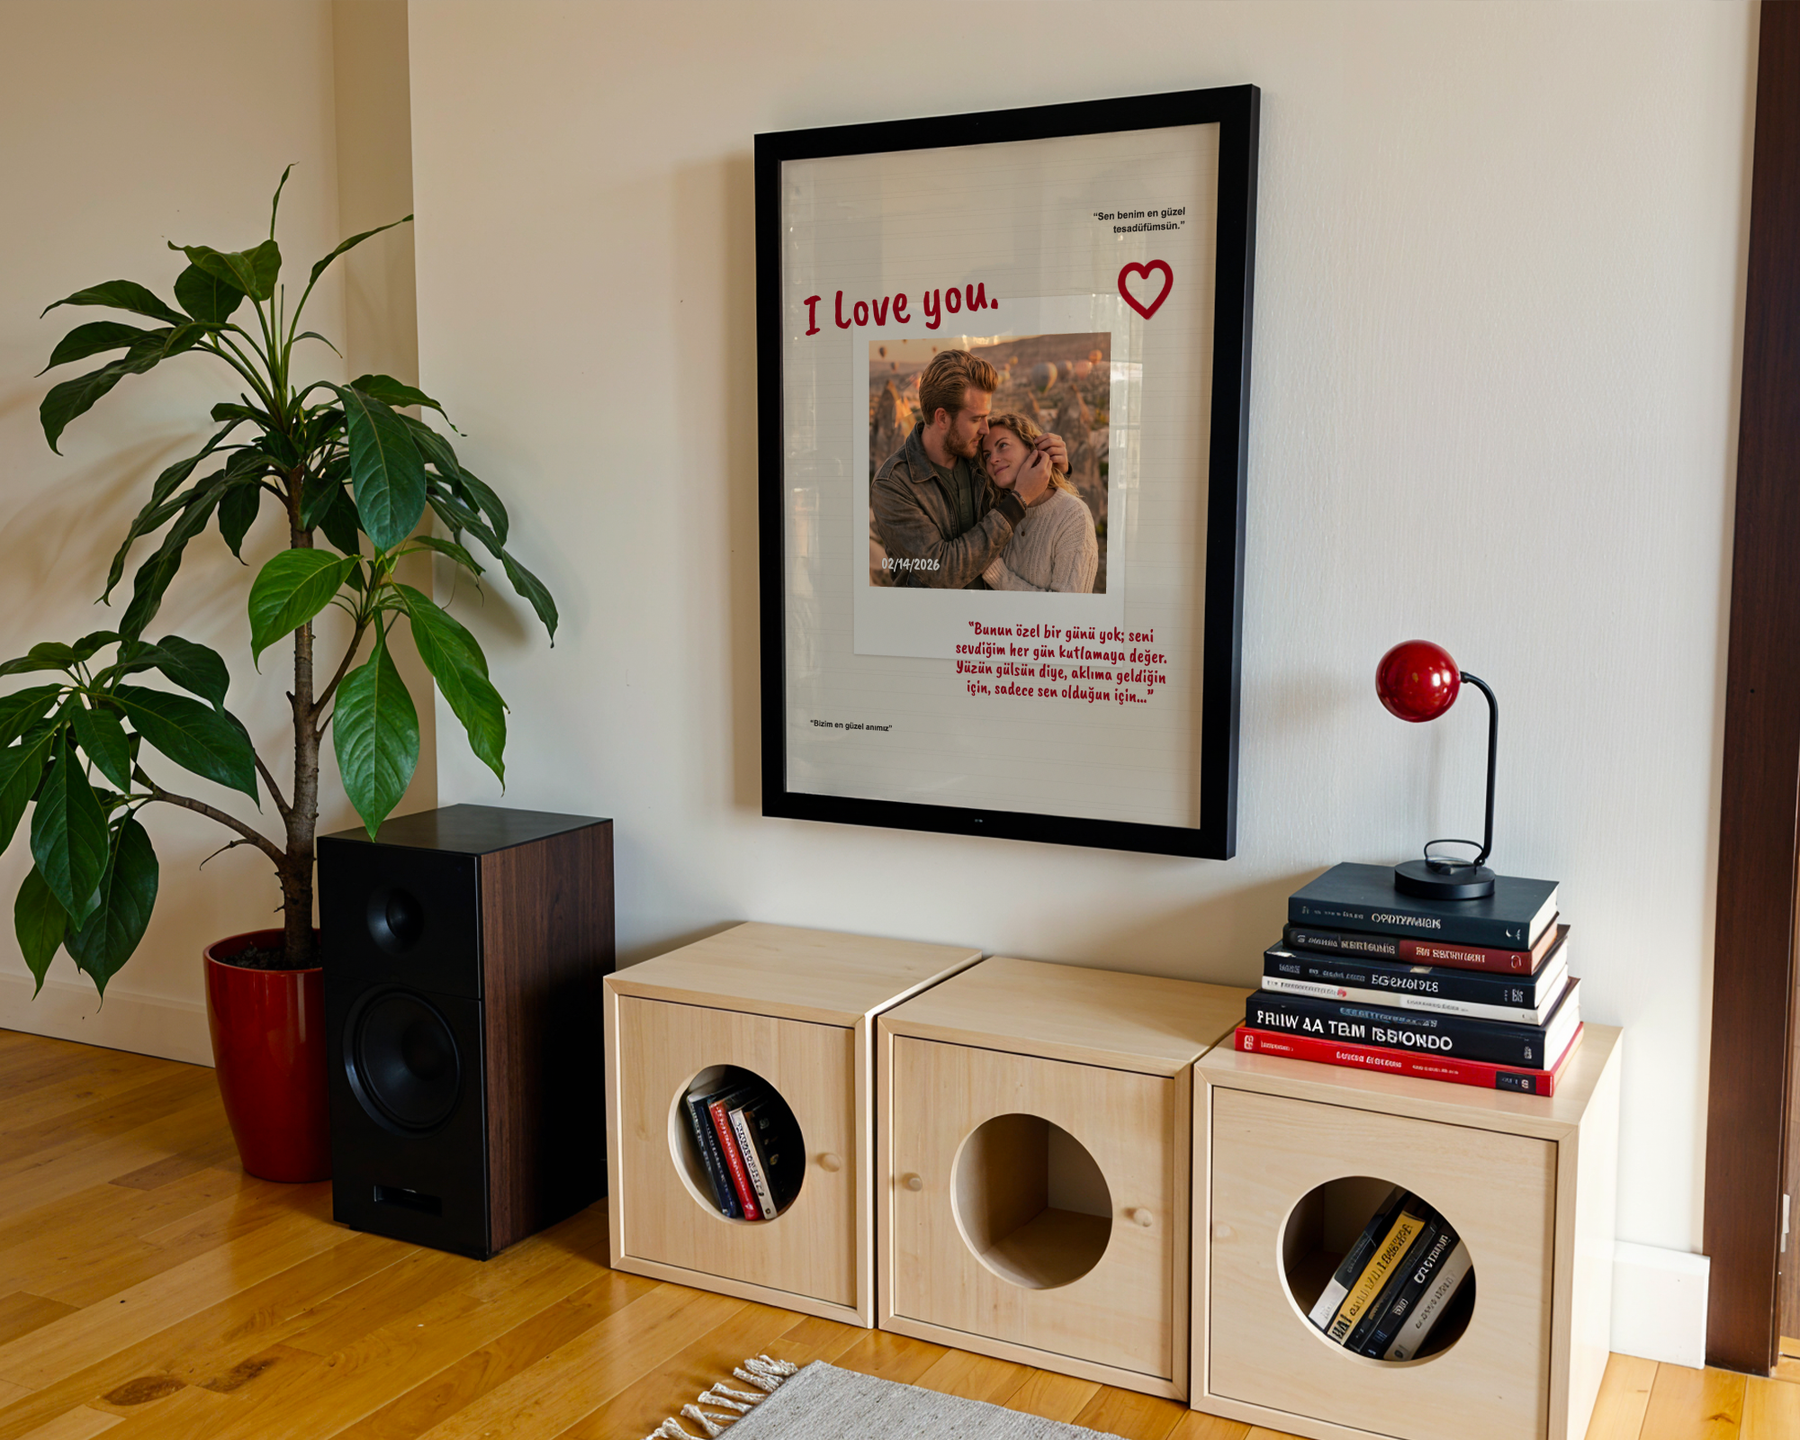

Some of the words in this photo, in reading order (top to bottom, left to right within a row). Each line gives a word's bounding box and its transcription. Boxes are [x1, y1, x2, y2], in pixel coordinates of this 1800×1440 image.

[1117, 209, 1145, 220] benim
[1147, 210, 1159, 218] en
[1161, 206, 1186, 219] güzel
[803, 294, 822, 336] I
[834, 291, 911, 330] love
[923, 282, 999, 330] you.
[881, 557, 940, 573] 02/14/2026
[1016, 624, 1039, 637] özel
[1044, 624, 1061, 638] bir
[1066, 626, 1095, 642] günü
[1100, 627, 1124, 644] yok;
[1129, 629, 1153, 642] seni
[956, 642, 1005, 658] sevdiğim
[1010, 643, 1029, 657] her
[1033, 645, 1055, 660] gün
[1059, 645, 1125, 665] kutlamaya
[1130, 648, 1167, 666] değer.
[956, 660, 992, 674] Yüzün
[996, 662, 1035, 678] gülsün
[1039, 663, 1067, 681] diye,
[1072, 666, 1112, 680] aklıma
[1117, 668, 1166, 686] geldiğin
[967, 680, 991, 696] için,
[995, 681, 1033, 697] sadece
[1038, 688, 1057, 697] sen
[1062, 685, 1110, 703] olduğun
[845, 722, 865, 731] güzel
